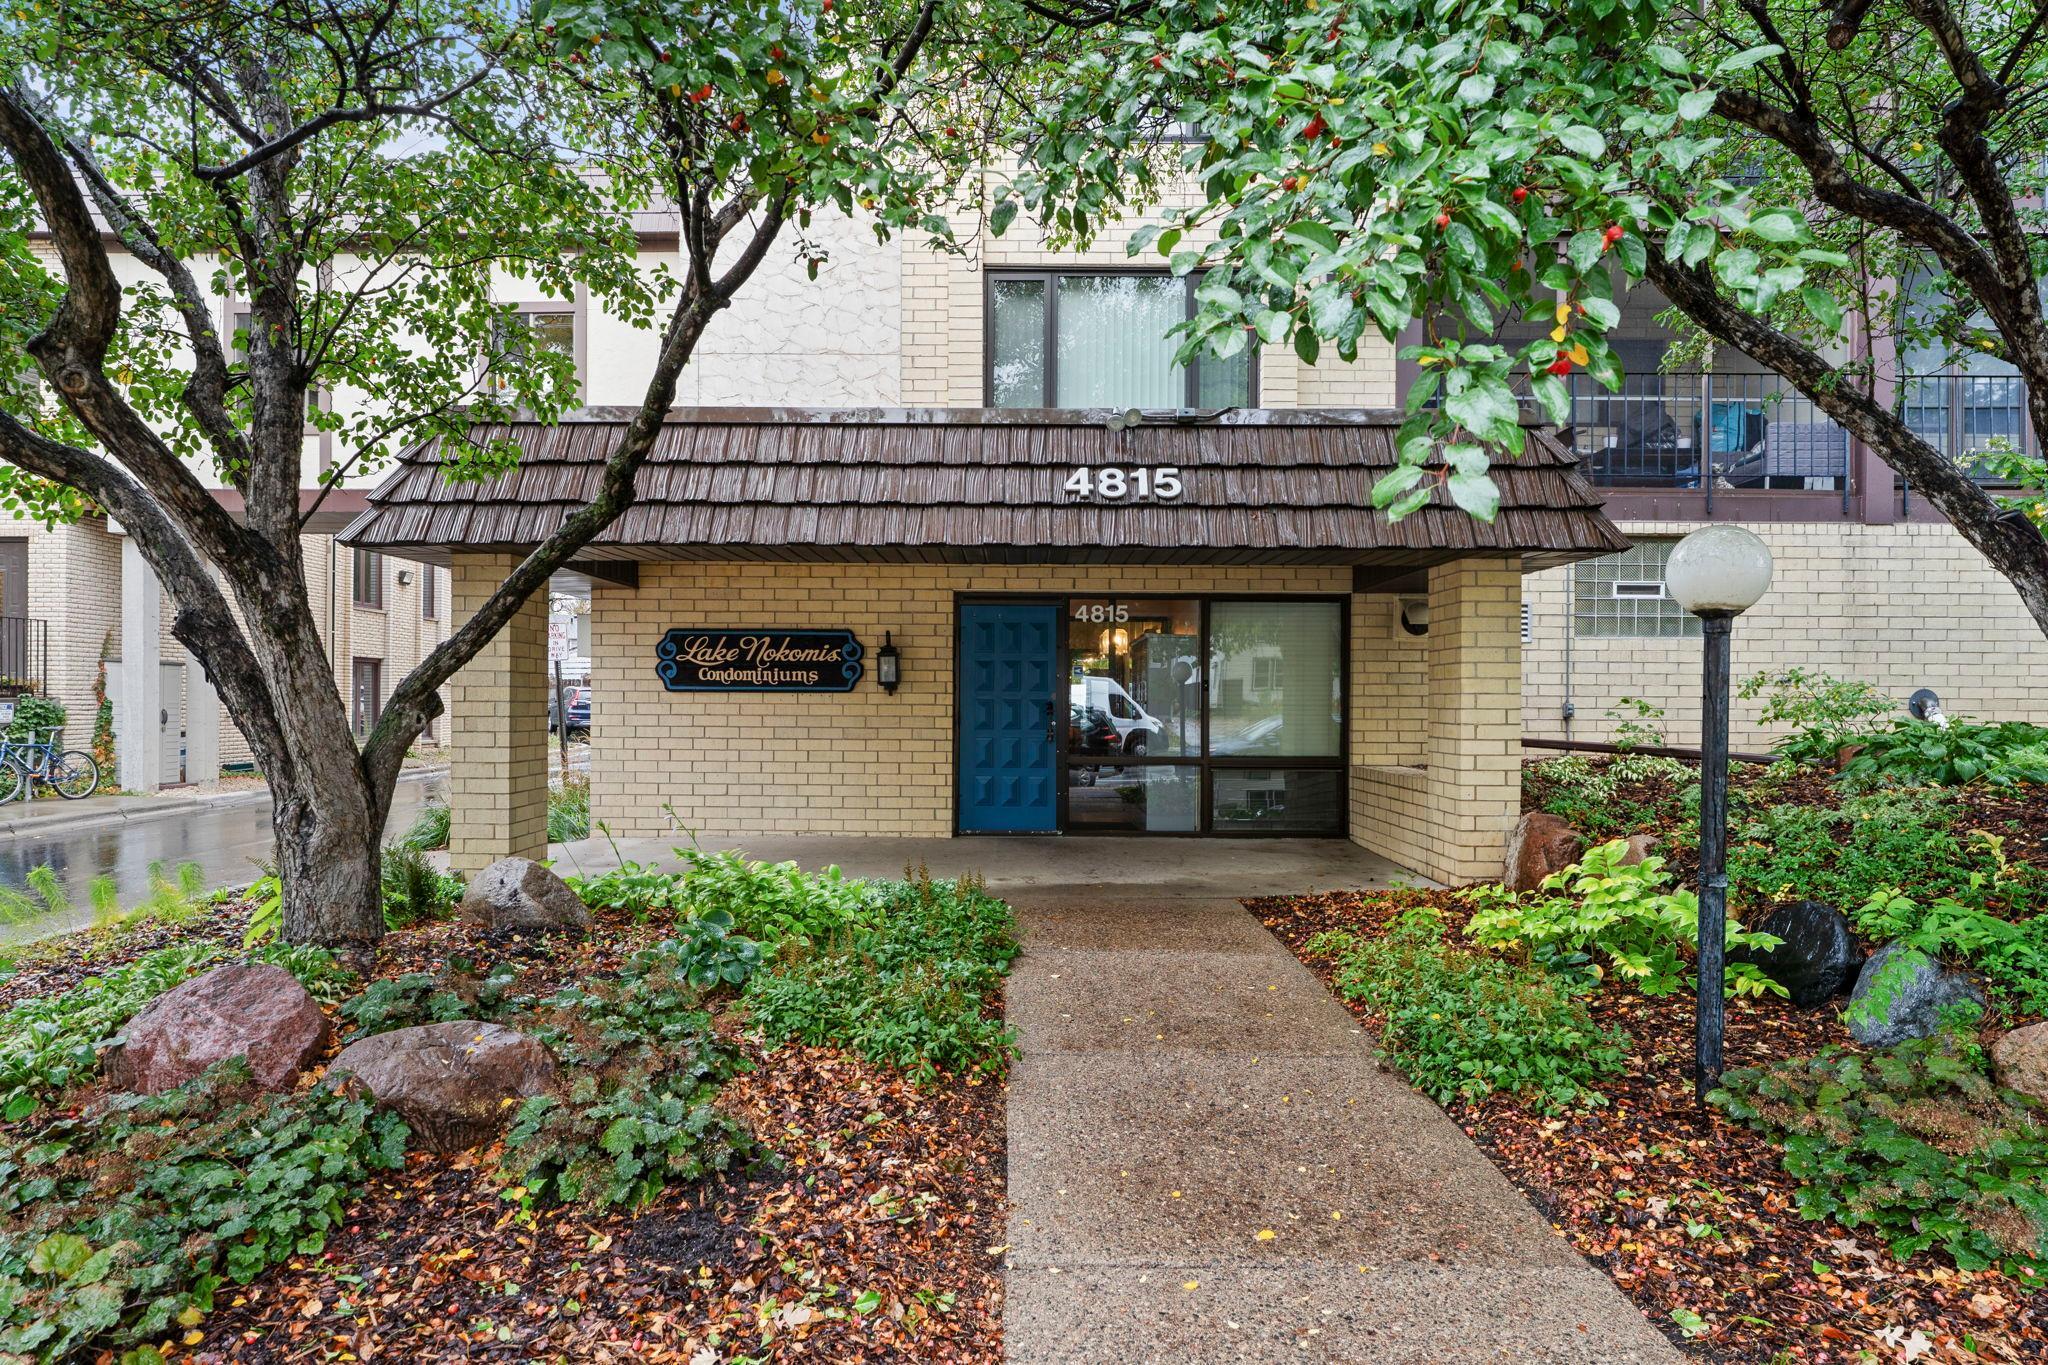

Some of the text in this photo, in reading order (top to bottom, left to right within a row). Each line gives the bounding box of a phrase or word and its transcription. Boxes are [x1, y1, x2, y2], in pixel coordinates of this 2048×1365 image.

[1065, 467, 1182, 499] 4815
[1075, 605, 1129, 623] 4815
[548, 632, 566, 640] RKING
[550, 624, 559, 632] NO
[676, 636, 842, 668] Lake Nokomis
[699, 667, 819, 685] Condominiums
